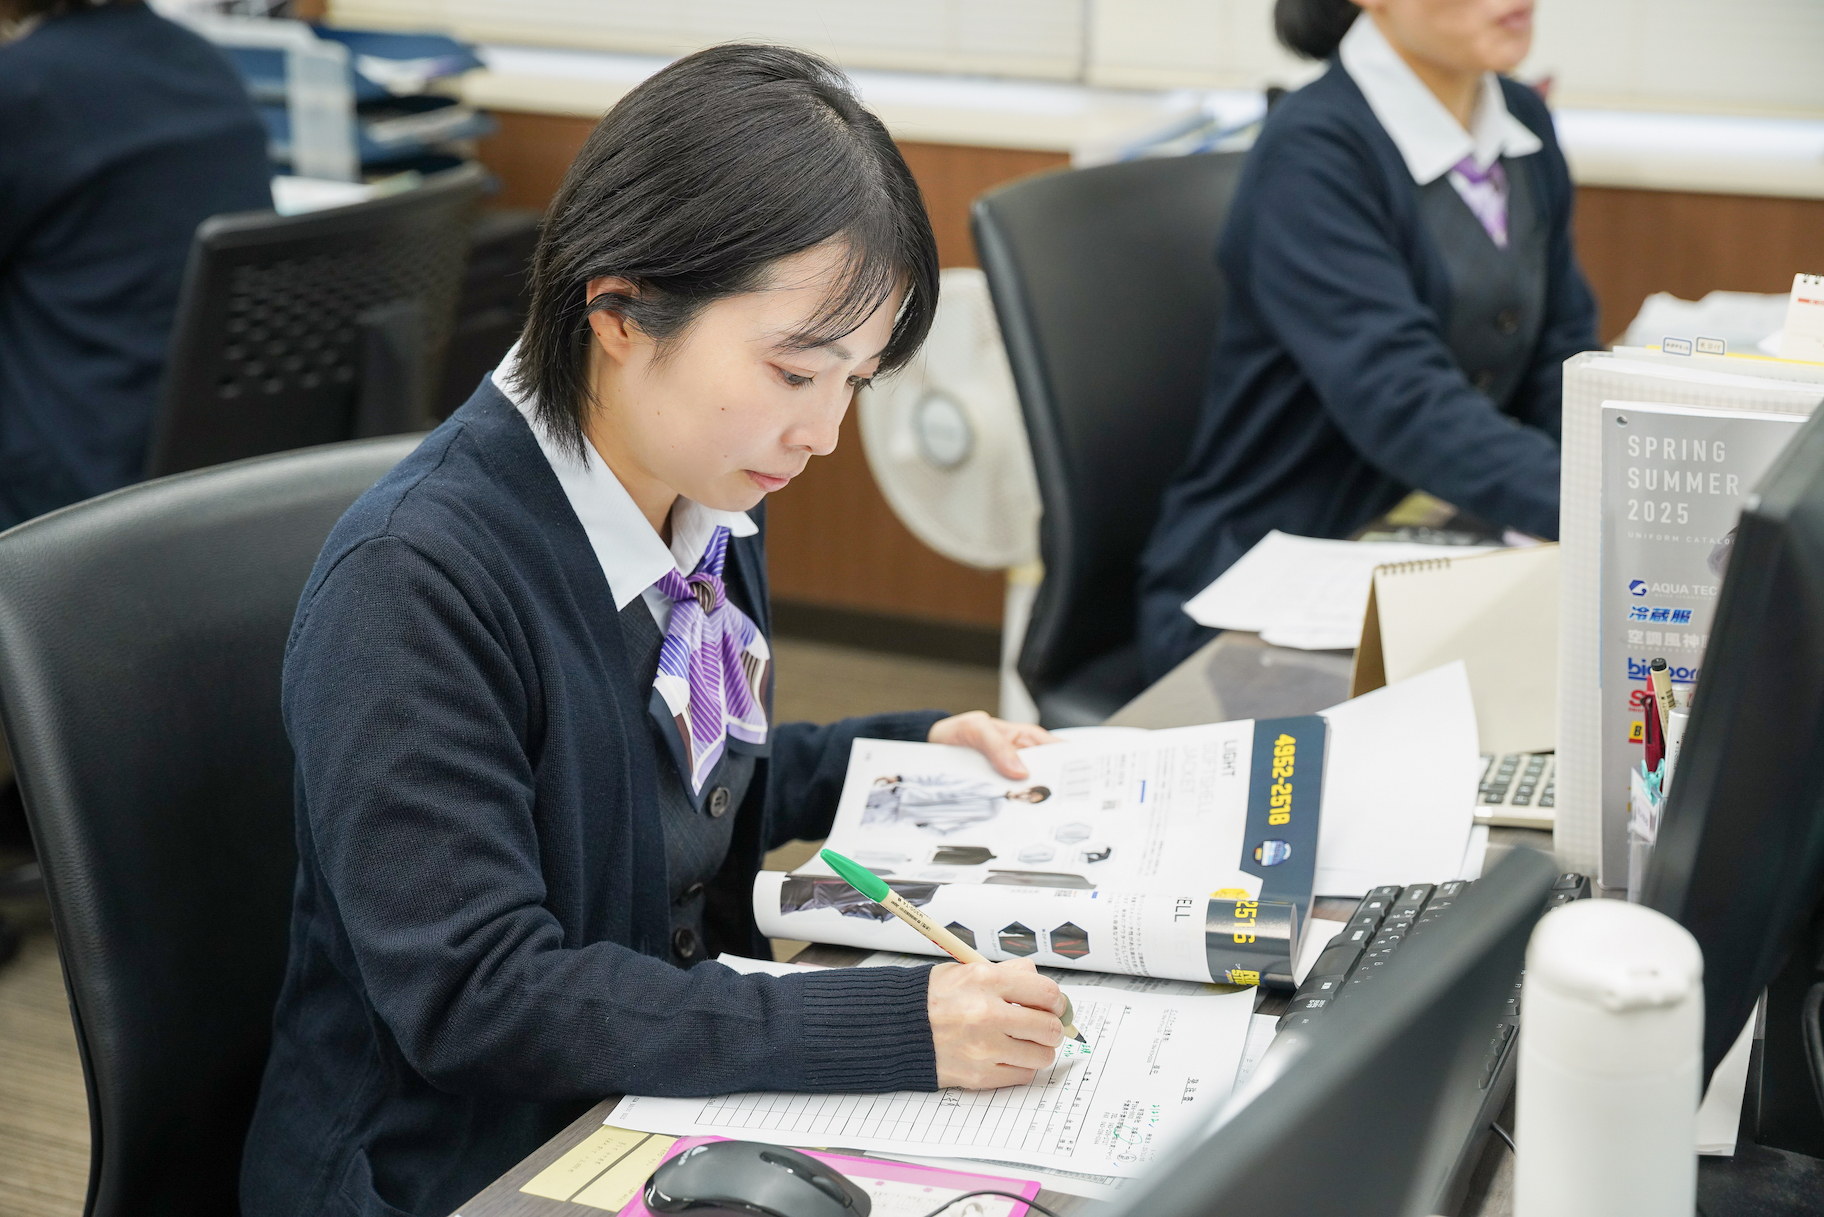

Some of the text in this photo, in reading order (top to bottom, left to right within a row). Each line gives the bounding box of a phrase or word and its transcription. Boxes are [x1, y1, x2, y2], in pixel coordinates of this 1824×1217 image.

[1627, 434, 1726, 463] SPRING
[1627, 466, 1739, 496] SUMMER
[1627, 498, 1689, 525] 2025
[1627, 531, 1679, 542] UNIFORM
[1651, 582, 1689, 596] AQUA
[1627, 605, 1693, 626] 冷蔵服
[1221, 739, 1238, 777] LIGHT
[1268, 733, 1297, 826] 4952-2518
